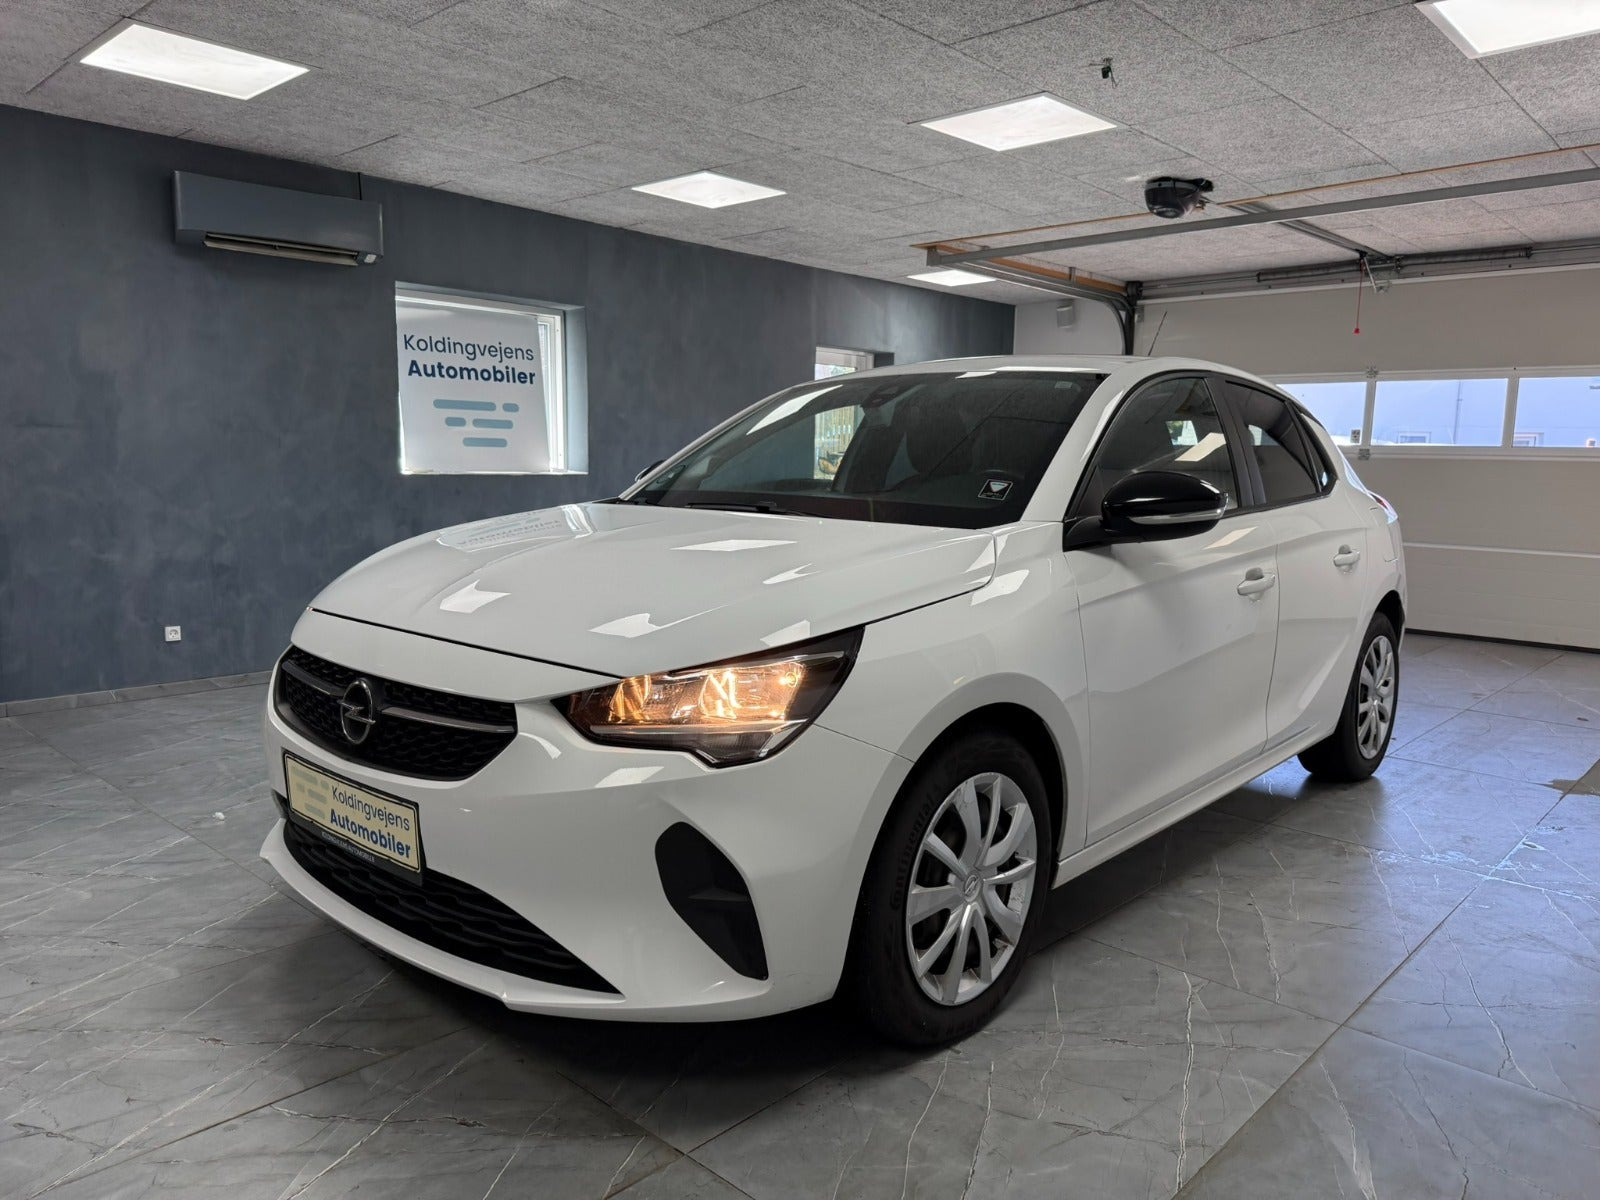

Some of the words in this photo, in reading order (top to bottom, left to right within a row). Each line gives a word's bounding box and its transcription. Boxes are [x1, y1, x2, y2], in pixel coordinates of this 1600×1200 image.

[403, 334, 534, 363] Koldingvejens
[408, 359, 536, 385] Automobiler
[332, 785, 410, 831] Koldingvejens
[330, 808, 411, 859] Automobiler
